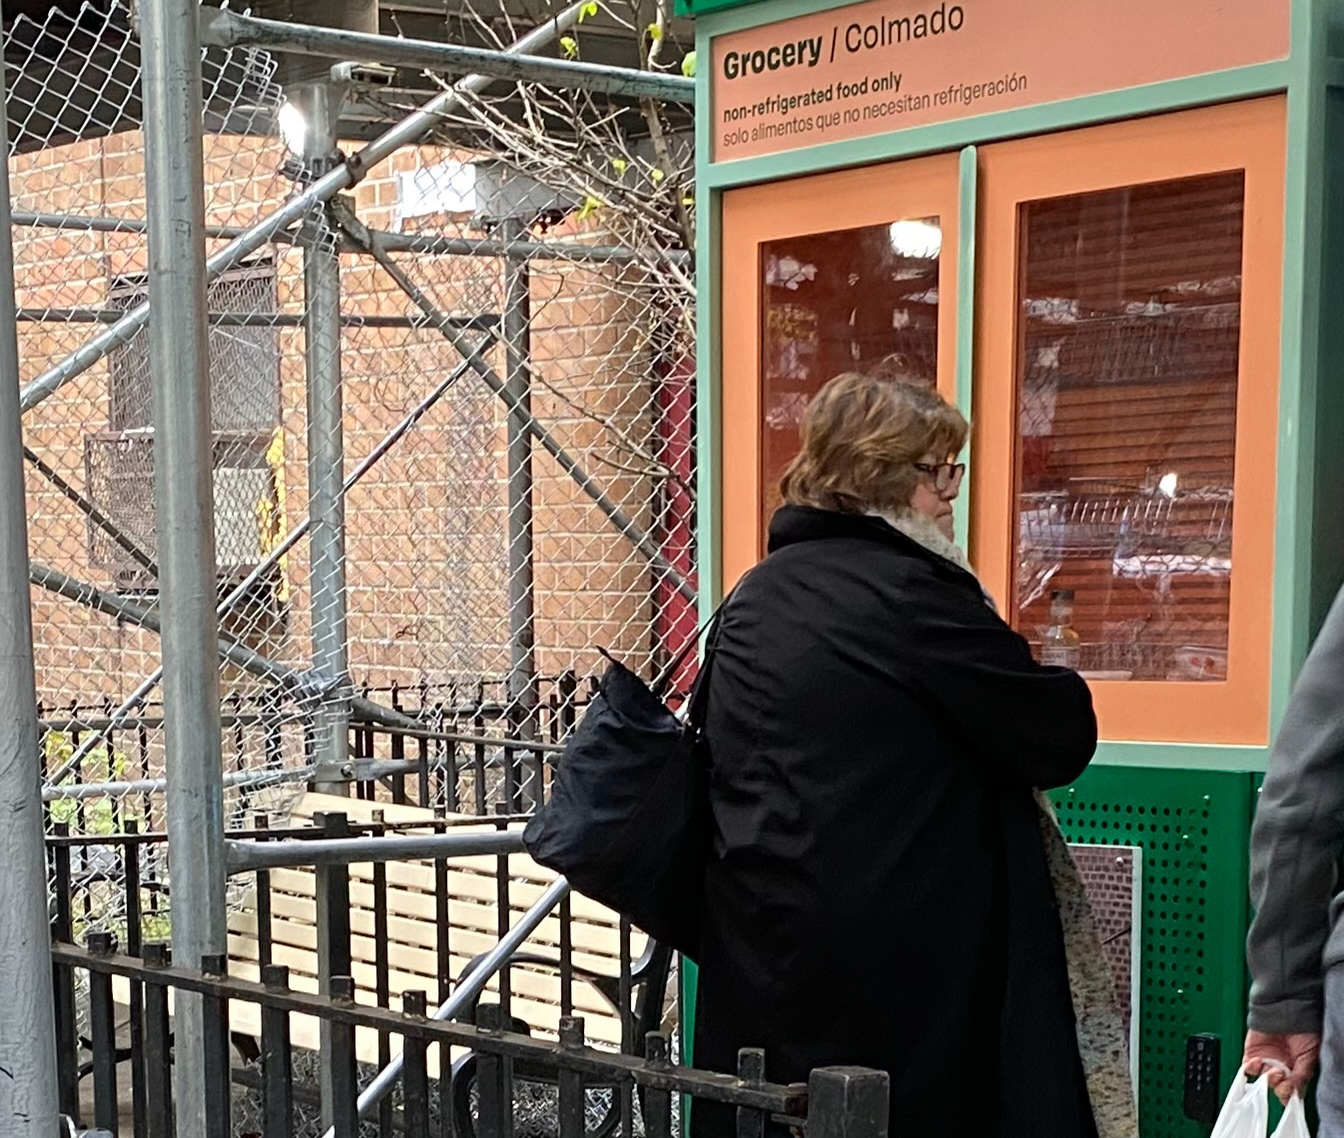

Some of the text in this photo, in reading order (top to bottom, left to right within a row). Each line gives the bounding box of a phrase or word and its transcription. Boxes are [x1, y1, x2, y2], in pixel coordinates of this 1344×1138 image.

[723, 34, 823, 80] Grocery
[845, 1, 964, 54] Colmado
[723, 71, 902, 123] non-refrigerated food only
[723, 72, 1027, 147] solo alimentos que no necesitan refrigeración
